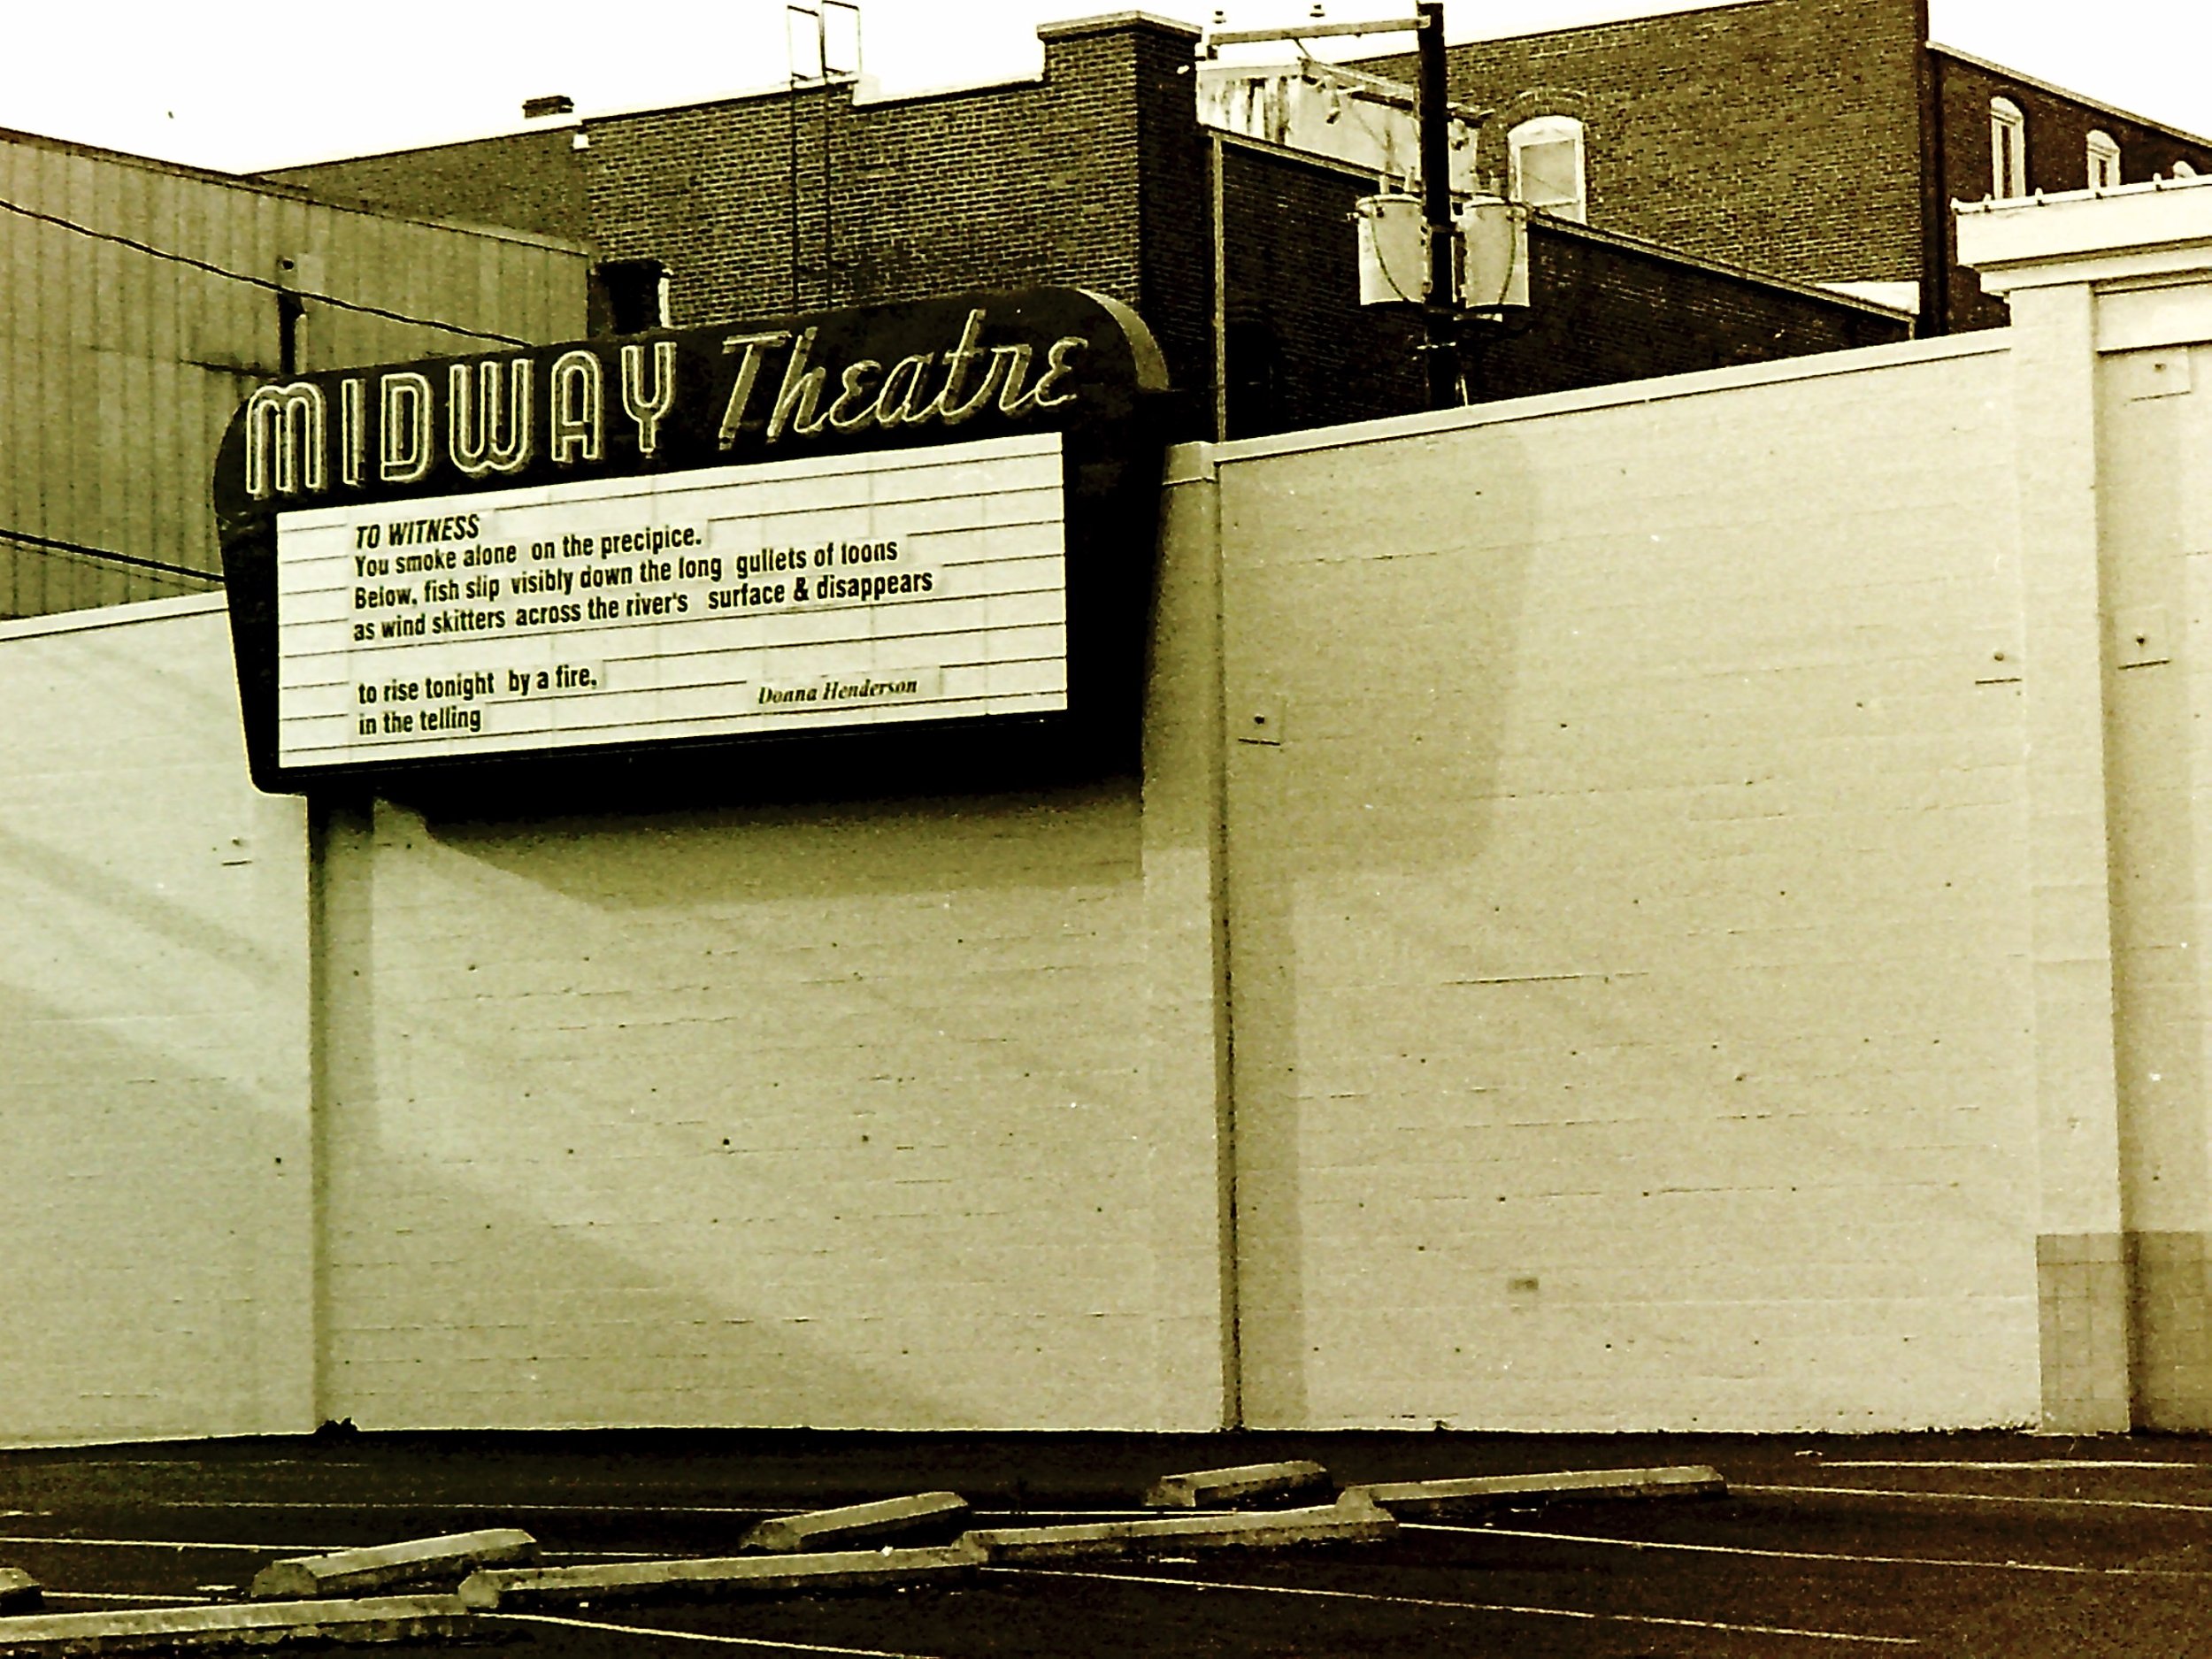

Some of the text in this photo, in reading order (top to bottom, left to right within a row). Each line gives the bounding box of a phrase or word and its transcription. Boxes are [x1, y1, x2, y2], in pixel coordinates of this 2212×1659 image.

[246, 308, 1089, 499] MIDWAY Theatre
[355, 526, 702, 578] You smoke alone on the precipice.
[357, 513, 480, 549] TO WITNESS
[424, 579, 460, 603] fish
[465, 575, 500, 602] slip
[511, 568, 573, 595] visibly
[580, 565, 633, 588] down
[640, 559, 672, 583] the
[679, 557, 722, 582] long
[736, 548, 807, 580] gullets
[814, 541, 834, 567] of
[841, 541, 898, 565] loons
[354, 572, 933, 641] as wind skitters across the river's surface & disappears
[358, 684, 377, 704] to
[383, 679, 419, 703] rise
[425, 672, 494, 699] tonight
[509, 670, 531, 696] by
[537, 671, 549, 689] a
[822, 679, 918, 701] Henderson
[359, 705, 481, 735] in the telling
